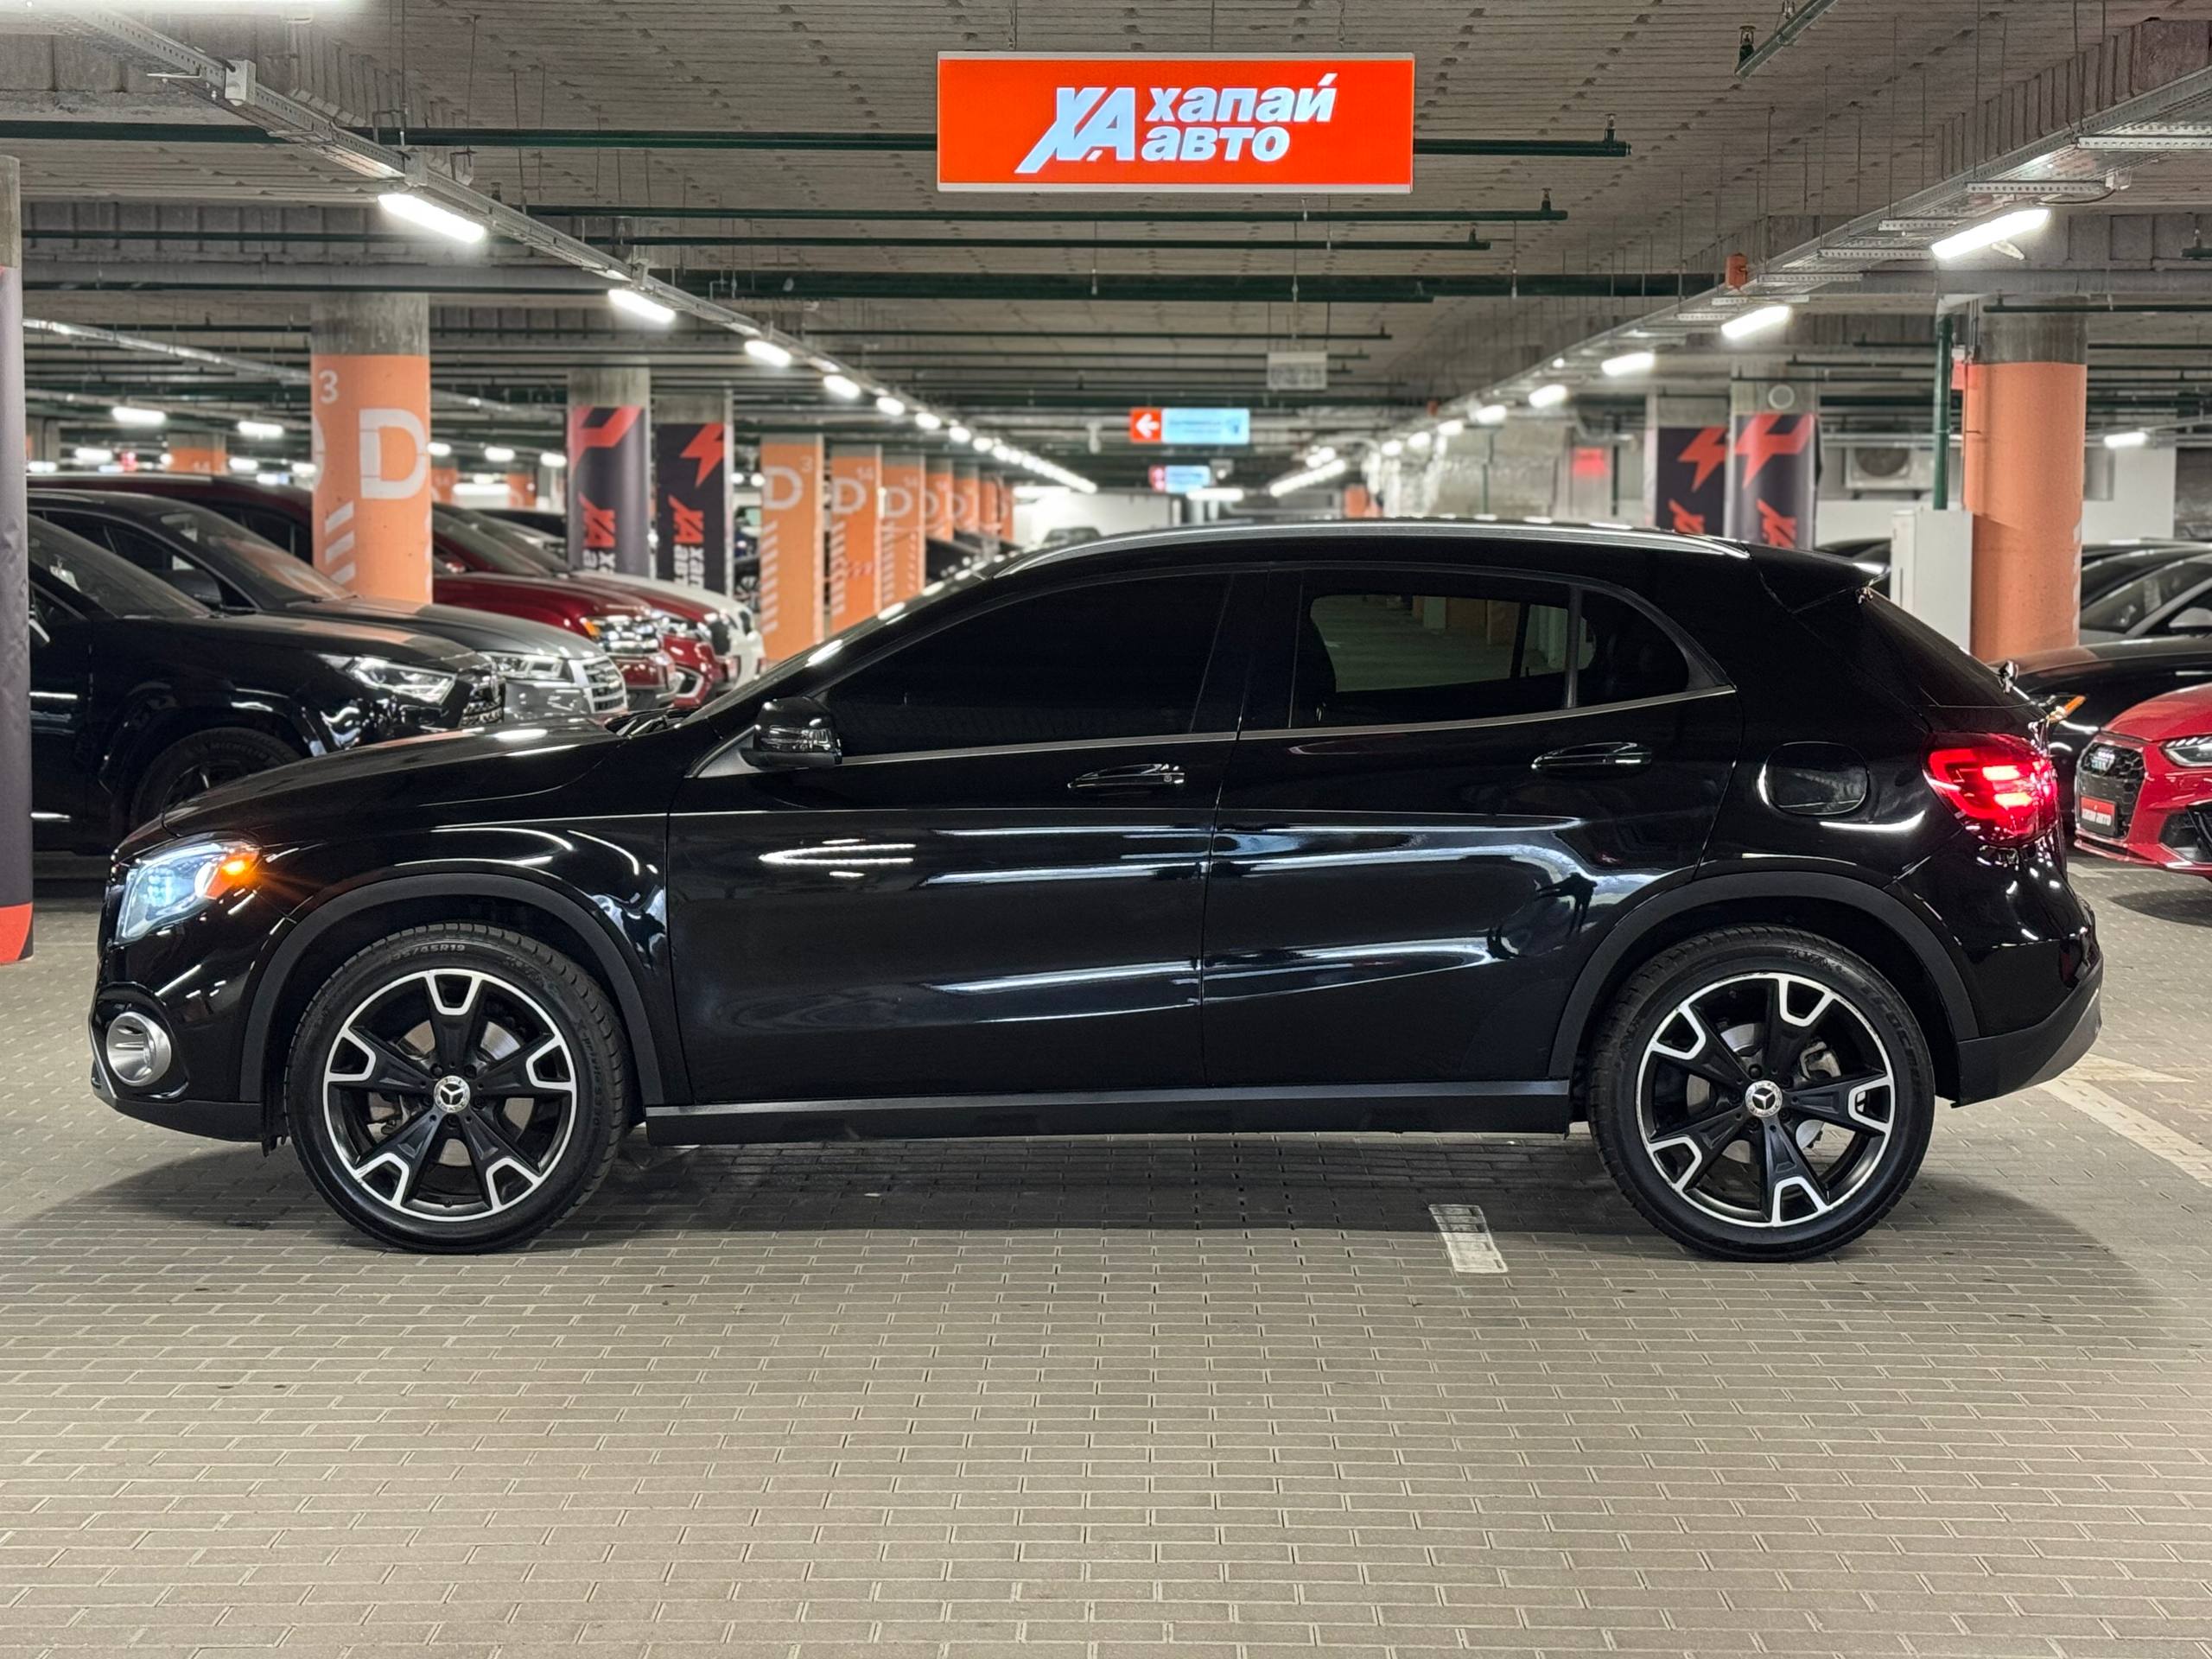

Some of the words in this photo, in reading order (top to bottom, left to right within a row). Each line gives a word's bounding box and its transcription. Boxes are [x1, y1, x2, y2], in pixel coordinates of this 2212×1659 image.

[1144, 73, 1338, 123] хапай
[1141, 126, 1290, 162] авто
[318, 369, 339, 404] 3
[359, 408, 428, 499] D
[761, 466, 804, 511] D
[831, 477, 867, 515] D
[884, 486, 913, 518] D
